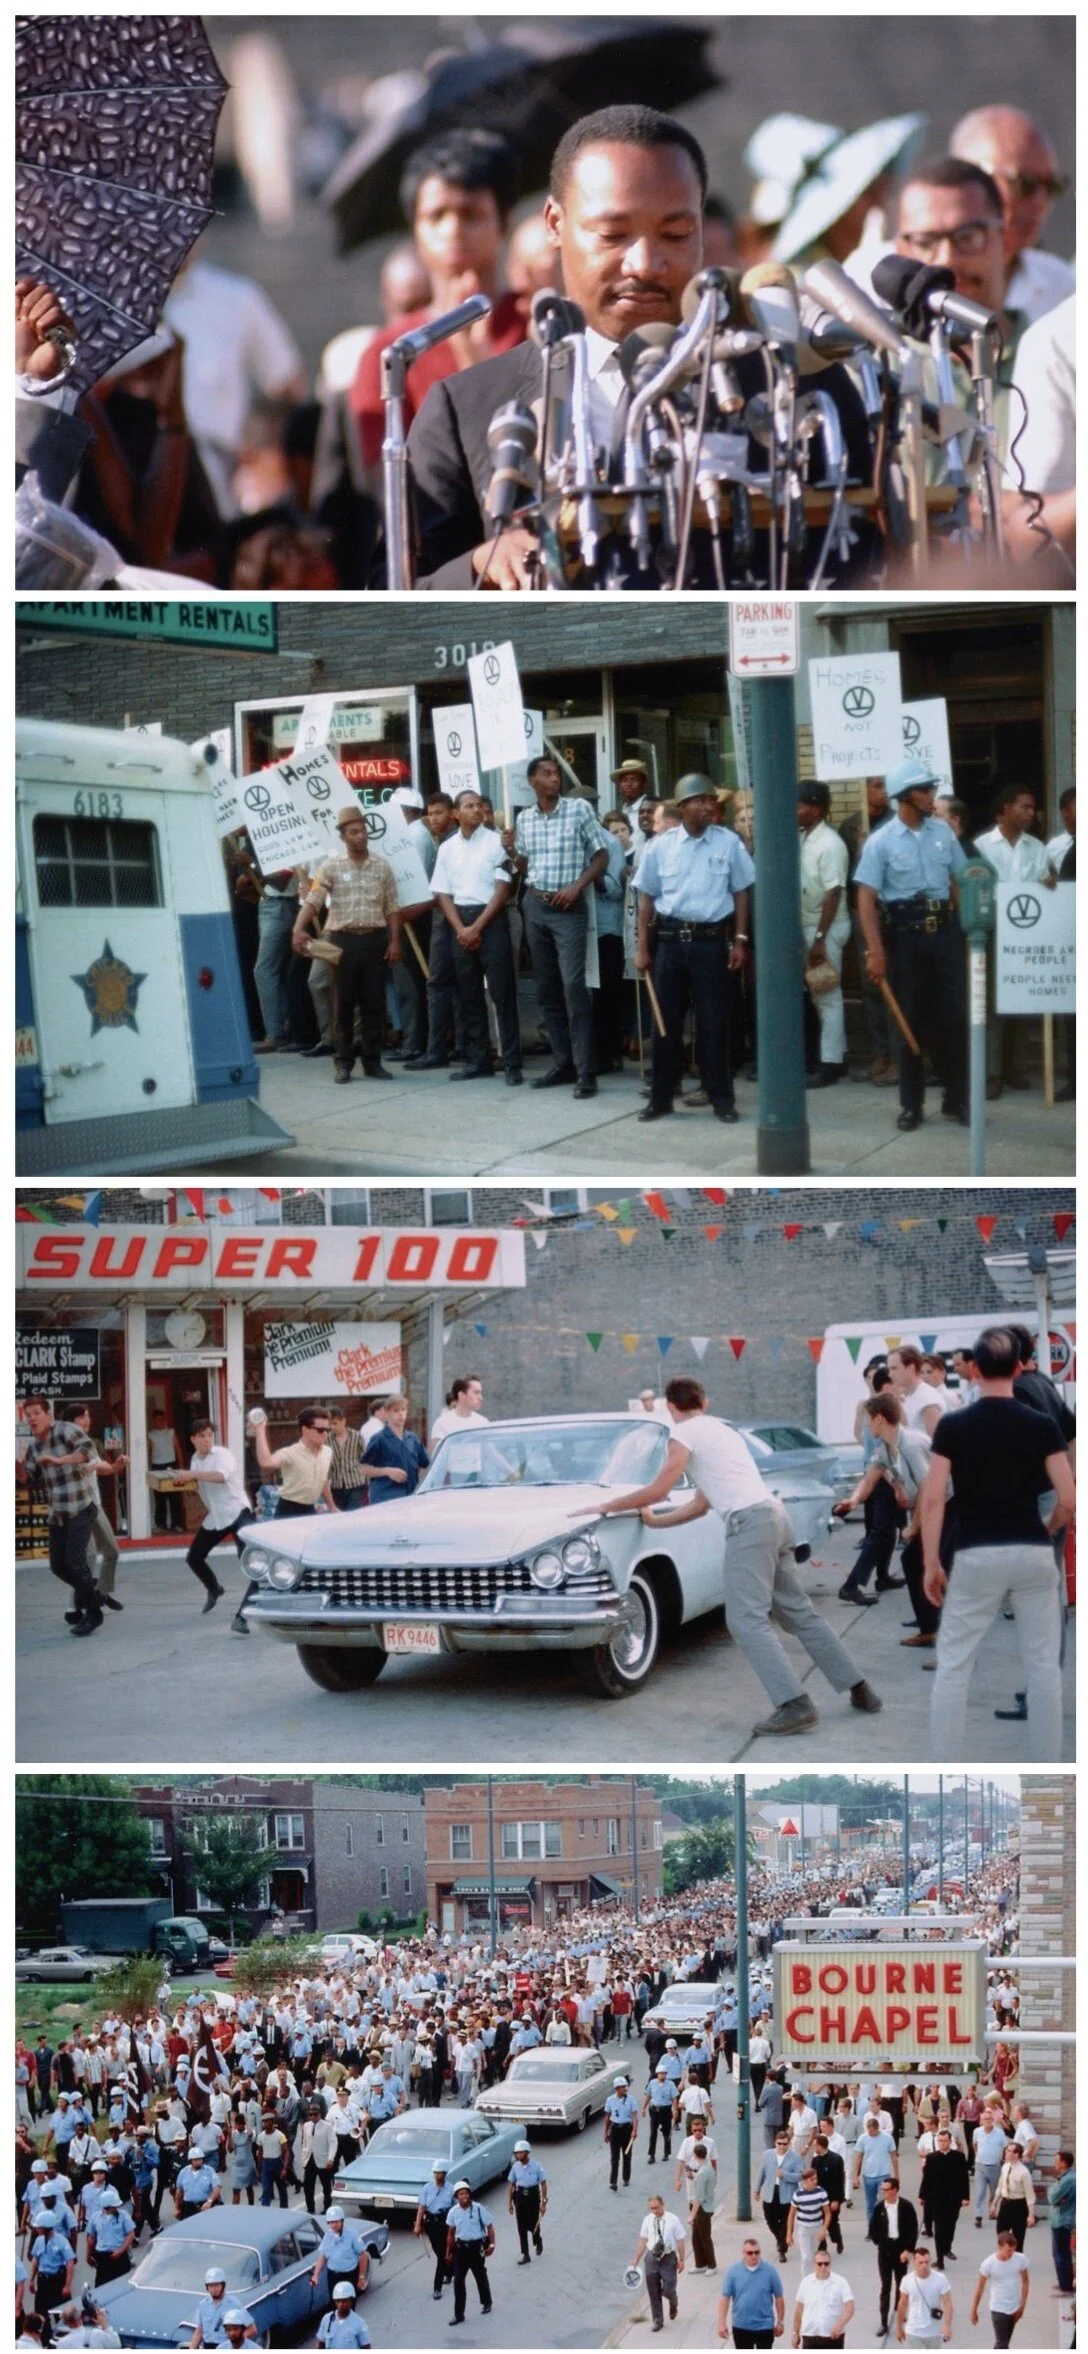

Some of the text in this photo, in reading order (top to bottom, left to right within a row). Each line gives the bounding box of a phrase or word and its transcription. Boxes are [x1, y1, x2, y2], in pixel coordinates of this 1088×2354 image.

[179, 604, 270, 637] RENTALS
[736, 602, 792, 623] PARKING
[844, 721, 872, 732] NOT
[340, 760, 400, 778] NTALS
[449, 773, 473, 788] LOVE
[74, 790, 124, 820] 6183
[259, 802, 296, 822] OPEN
[260, 847, 298, 865] CHICAGO
[1060, 944, 1075, 955] AR
[1024, 955, 1067, 965] PEOPLE
[1003, 974, 1044, 984] PEOPLE
[1028, 987, 1068, 996] HOMES
[27, 1236, 498, 1281] SUPER 100
[15, 1346, 95, 1371] CLARK Stamp
[337, 1342, 371, 1366] Clark
[22, 1372, 48, 1384] Plaid
[51, 1371, 93, 1387] Stamps
[334, 1366, 355, 1382] the
[387, 1629, 436, 1647] RK 9446
[792, 1963, 962, 1995] BOURNE
[786, 2006, 971, 2044] CHAPEL
